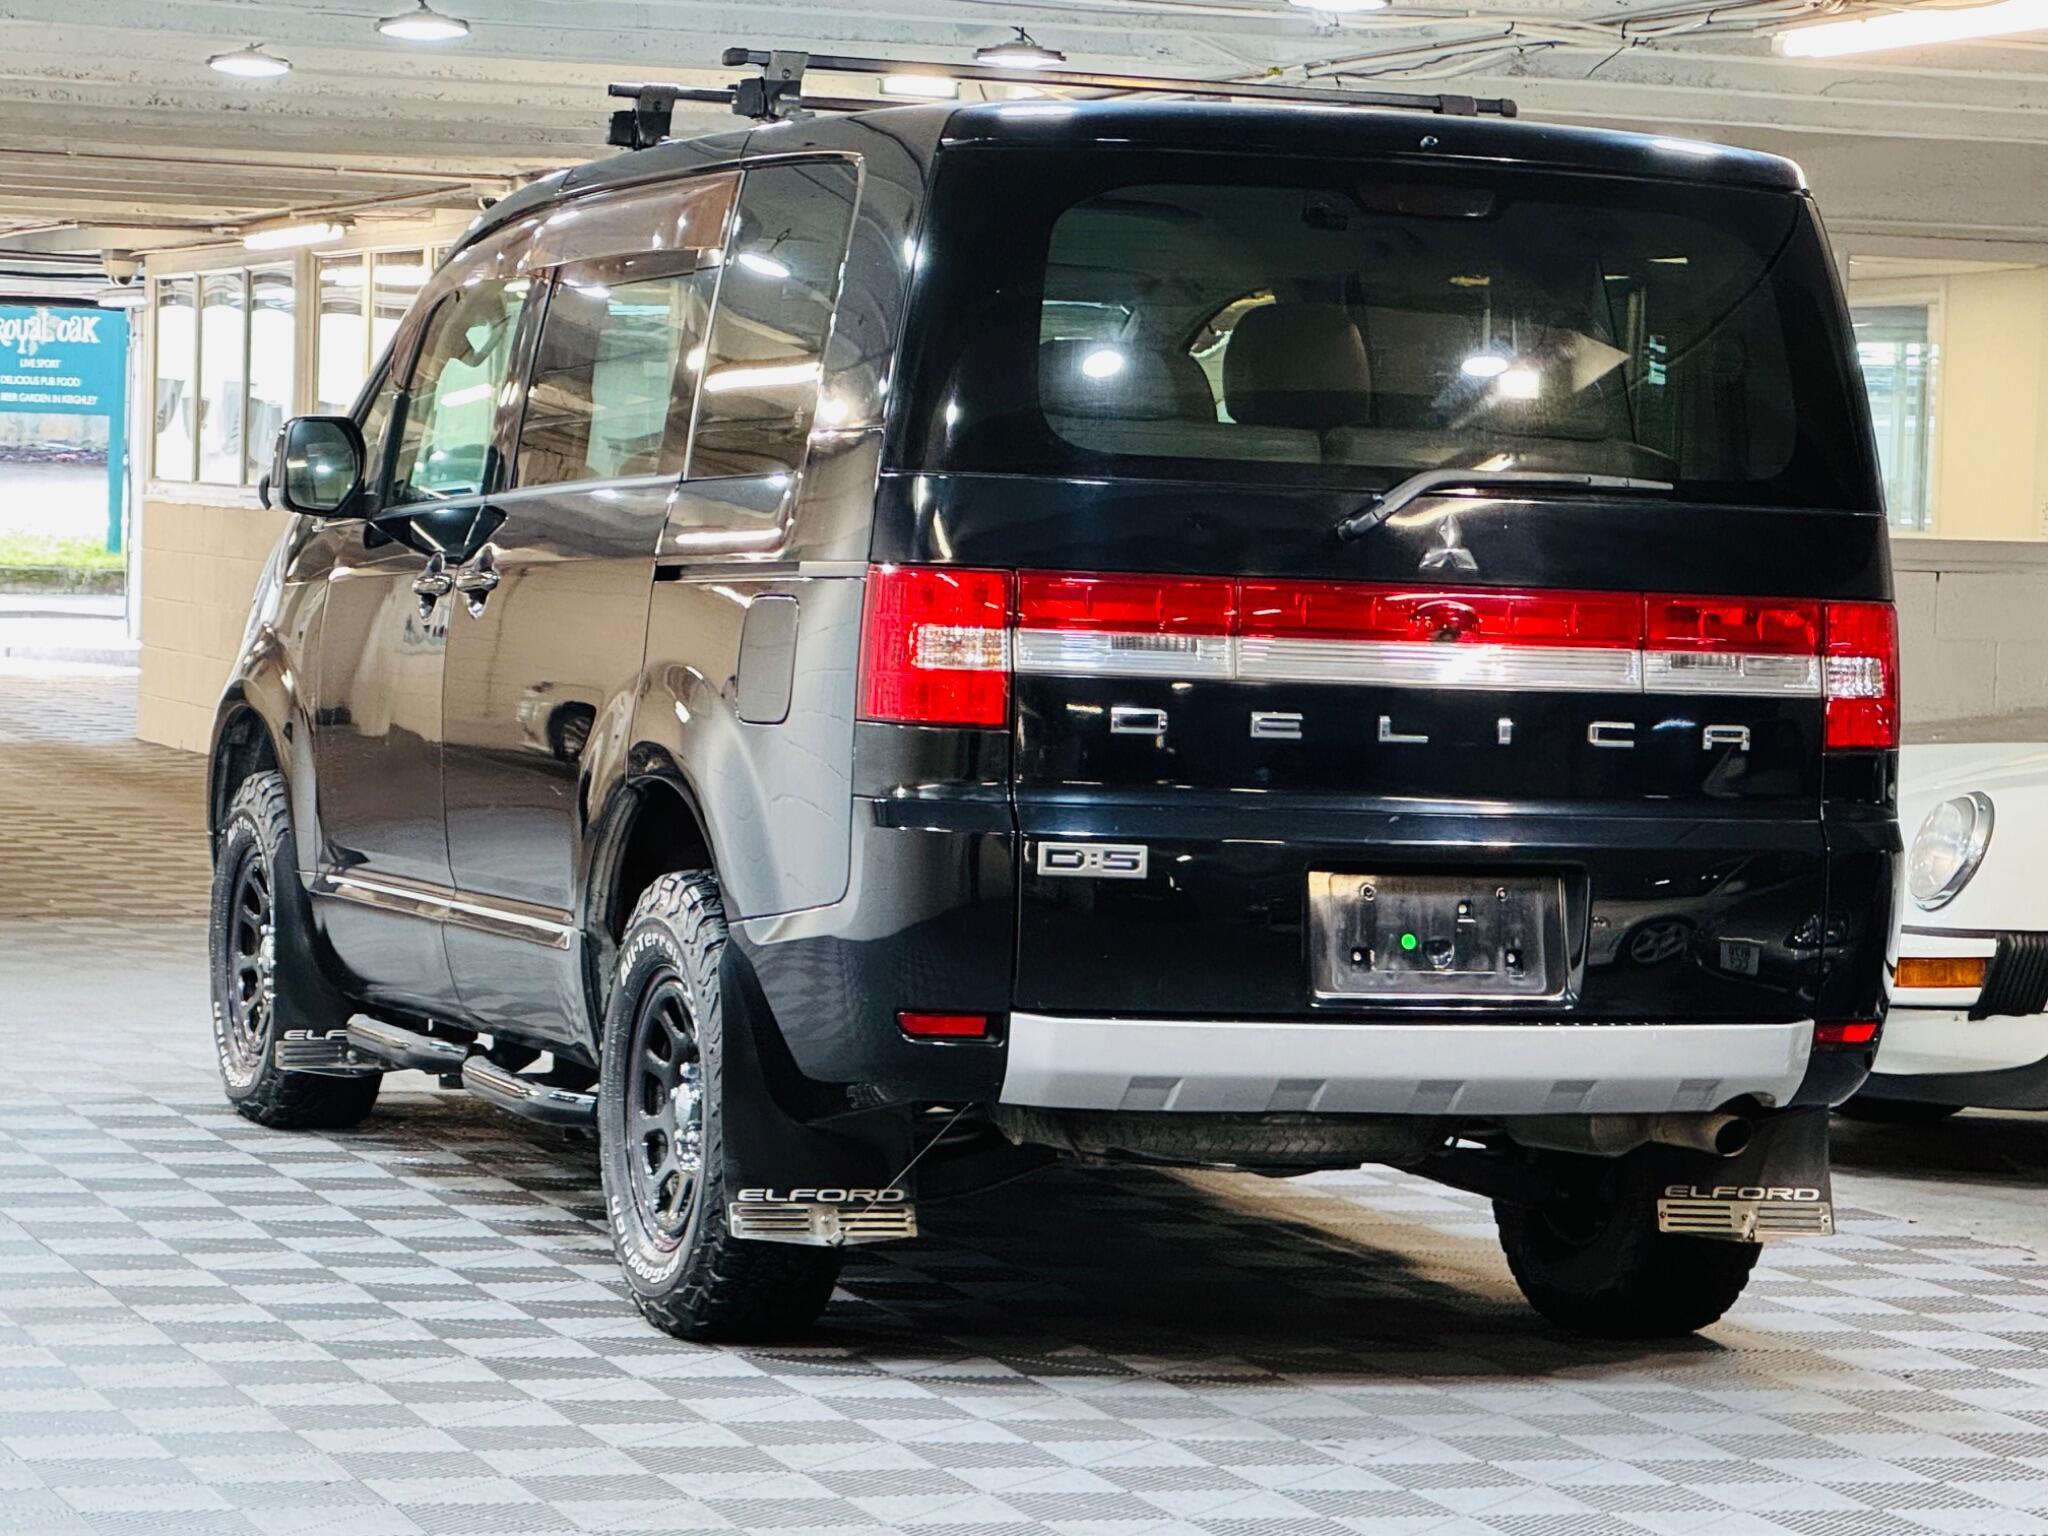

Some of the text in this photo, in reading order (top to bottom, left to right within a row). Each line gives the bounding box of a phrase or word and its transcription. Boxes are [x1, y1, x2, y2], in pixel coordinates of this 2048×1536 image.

[37, 359, 61, 369] SPORT
[1110, 705, 1751, 752] DELICA
[737, 1188, 905, 1202] ELFORD
[1664, 1185, 1820, 1201] ELFORD
